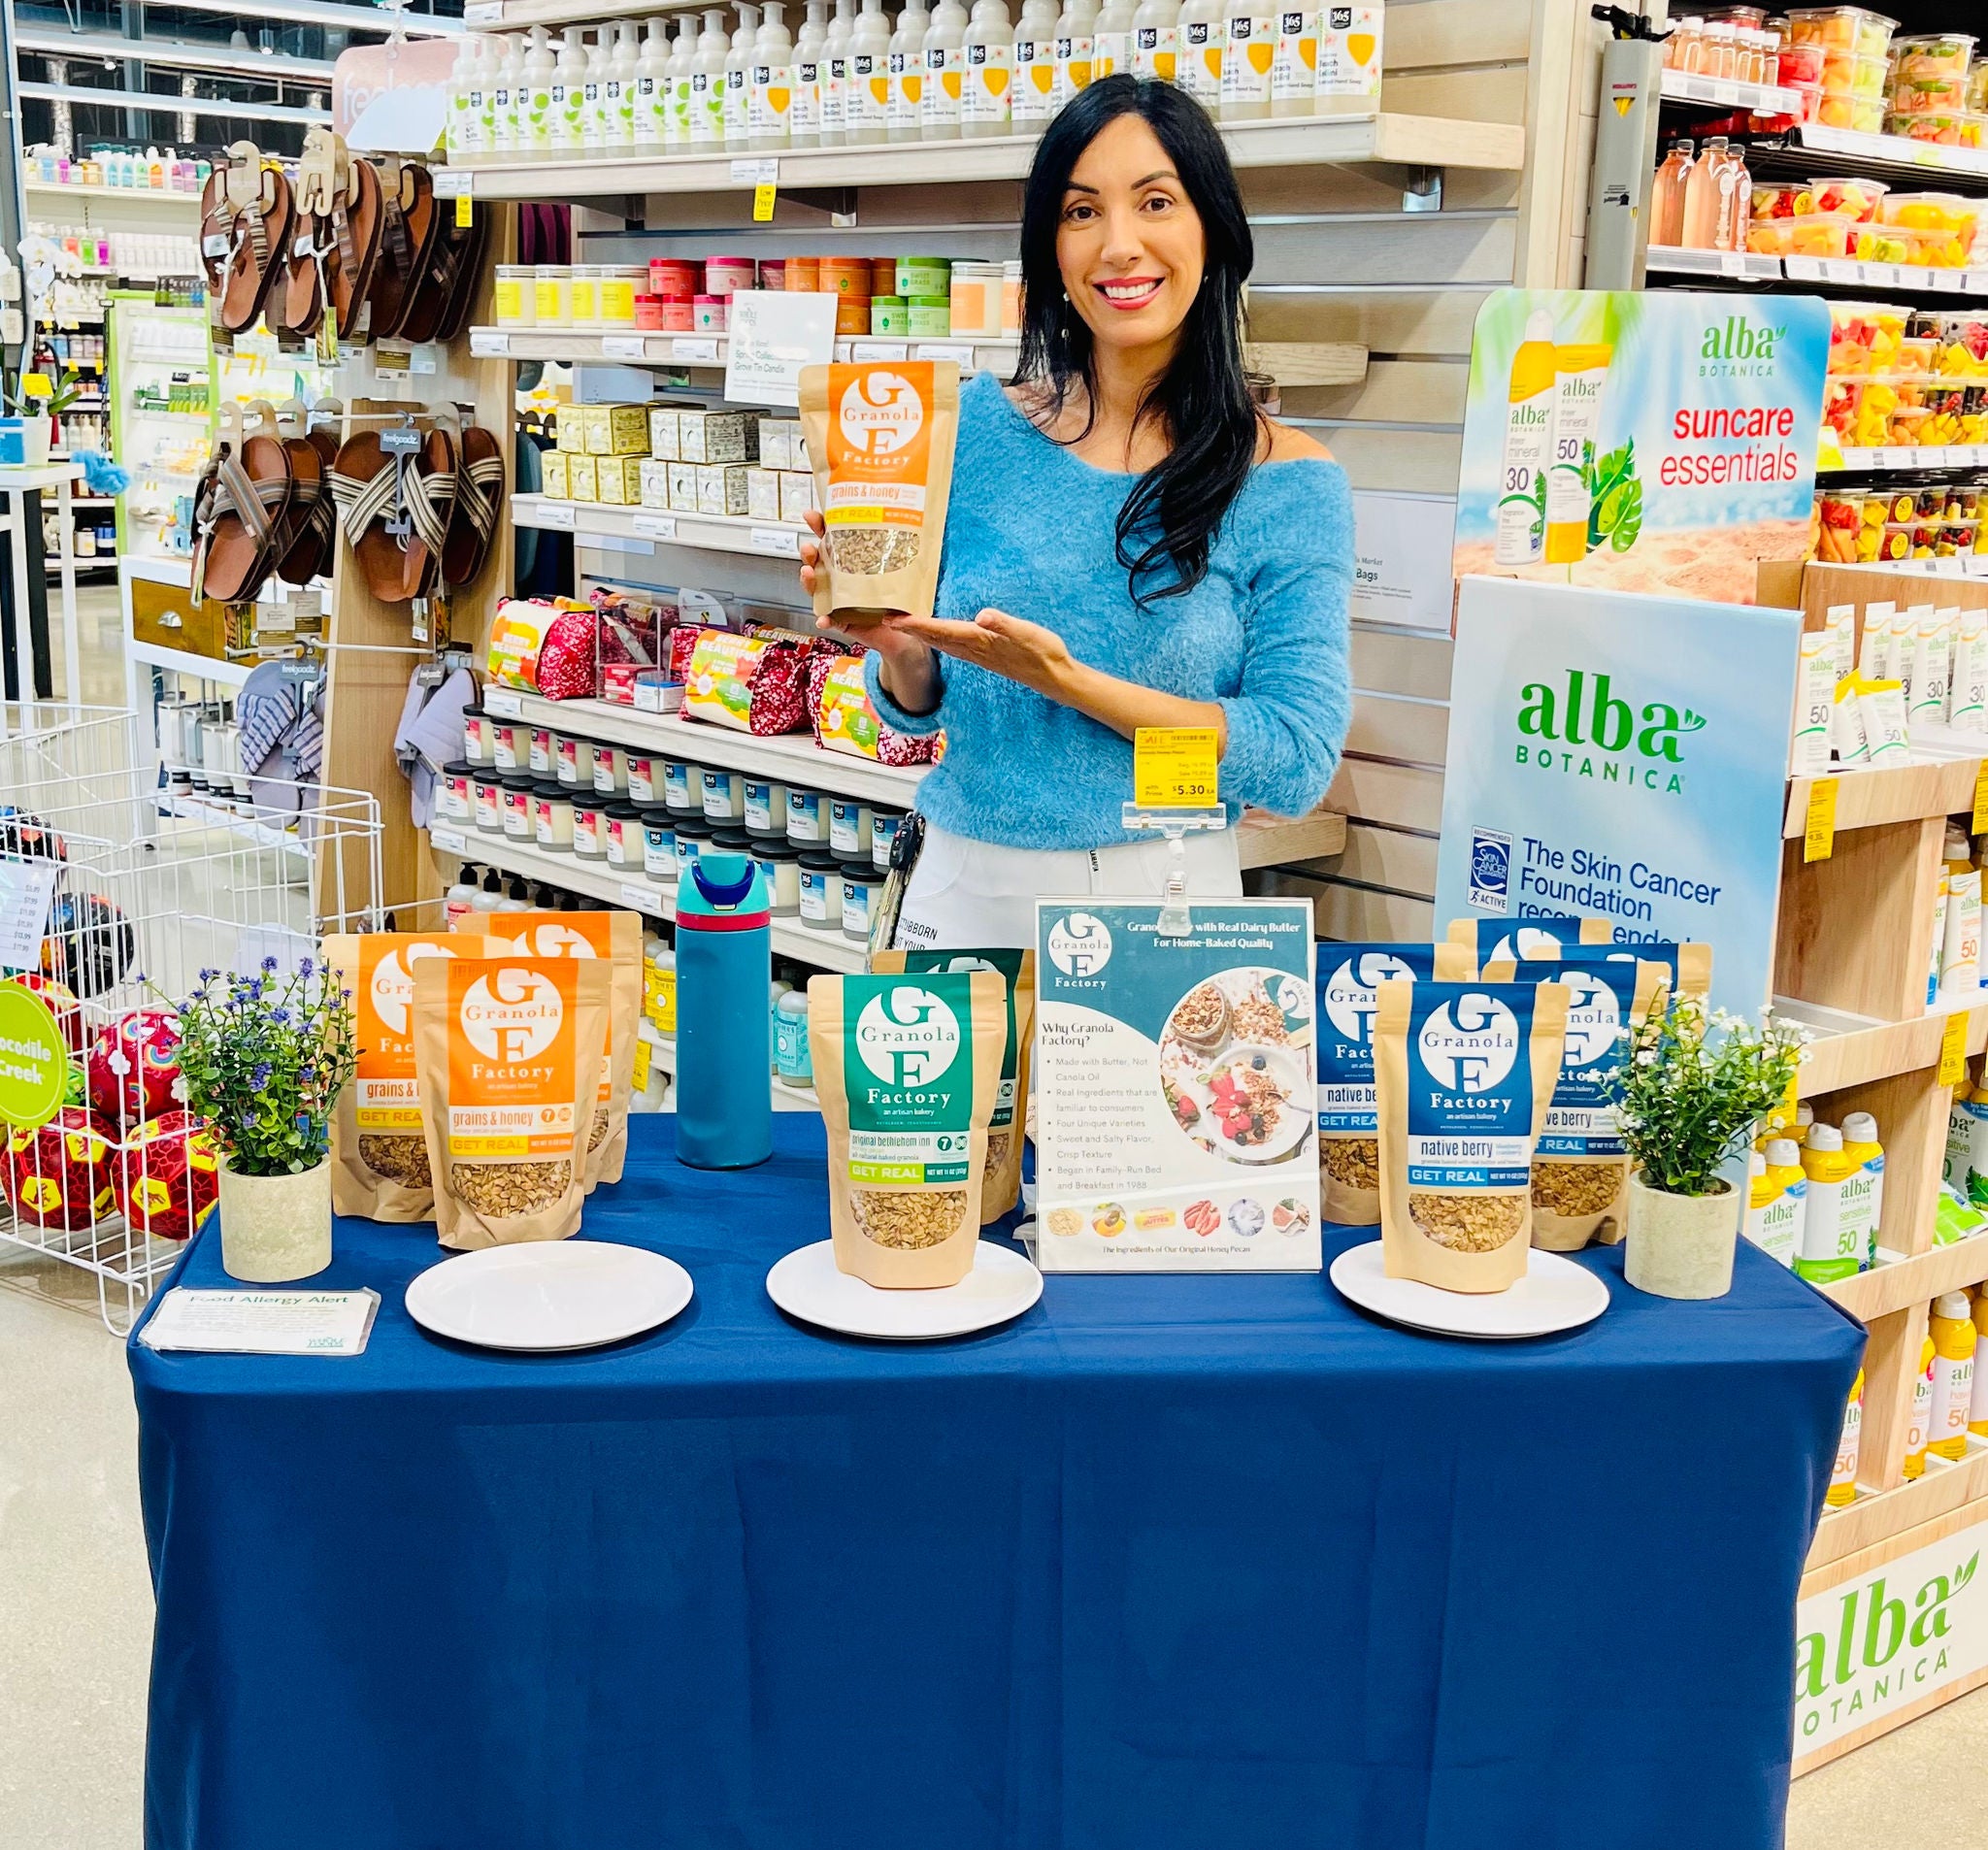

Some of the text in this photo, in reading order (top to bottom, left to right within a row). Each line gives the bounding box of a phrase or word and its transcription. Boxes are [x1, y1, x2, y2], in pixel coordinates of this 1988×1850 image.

[1284, 15, 1303, 28] 365
[1331, 10, 1351, 22] 365
[1188, 25, 1208, 39] 365
[1233, 20, 1251, 33] 365
[855, 56, 872, 69] 365
[1701, 316, 1780, 360] alba
[1699, 364, 1774, 378] BOTANICA
[1563, 379, 1599, 397] alba
[844, 407, 919, 422] Granola
[1510, 405, 1548, 424] alba
[1673, 408, 1794, 440] suncare
[1557, 439, 1578, 459] 50
[843, 450, 911, 467] Factory
[1660, 442, 1798, 486] essentials
[1506, 467, 1530, 491] 30
[831, 486, 859, 500] grains
[870, 485, 900, 501] honey
[1356, 569, 1379, 582] Bags
[1927, 680, 1943, 698] 30
[1970, 685, 1986, 703] 30
[1517, 669, 1694, 763] alba
[1809, 705, 1829, 724] 50
[1884, 729, 1901, 742] 50
[1515, 744, 1684, 794] BOTANICA
[1173, 784, 1205, 795] $5.30
[1474, 829, 1511, 842] RECOMMENDED
[1479, 848, 1500, 864] SKIN
[1473, 856, 1508, 874] CANCER
[1523, 838, 1722, 907] The Skin Cancer
[1481, 894, 1507, 908] ACTIVE
[1520, 868, 1653, 921] Foundation
[1196, 922, 1301, 935] with Real Dairy Butter
[1051, 939, 1110, 950] Granola
[1153, 938, 1274, 950] For Home-Baked Quality
[1961, 940, 1977, 958] 50
[1054, 977, 1107, 991] Factory
[465, 1004, 560, 1020] Granola
[861, 1026, 955, 1043] Granola
[1042, 1022, 1114, 1037] Why Granola
[1042, 1036, 1091, 1049] Factory?
[1424, 1031, 1513, 1048] Granola
[1055, 1057, 1148, 1069] Made with Butter, Not
[472, 1064, 555, 1083] Factory
[1055, 1073, 1100, 1081] Canola Oil
[367, 1082, 415, 1099] grains &
[867, 1088, 951, 1108] Factory
[1056, 1088, 1075, 1097] Real
[1077, 1088, 1123, 1099] Ingredients
[1126, 1088, 1140, 1097] that
[1328, 1088, 1362, 1103] native
[1056, 1104, 1086, 1112] familiar
[1430, 1093, 1512, 1113] Factory
[361, 1111, 389, 1122] GET
[453, 1111, 534, 1127] grains & honey
[1320, 1116, 1347, 1126] GET
[1562, 1110, 1592, 1129] berry
[1056, 1119, 1146, 1130] Four Unique Varieties
[452, 1140, 482, 1150] GET
[486, 1140, 525, 1150] REAL
[852, 1135, 930, 1148] original bethlehem inn
[1056, 1135, 1154, 1145] Sweet and Salty Flavor,
[1545, 1140, 1583, 1151] REAL
[1056, 1150, 1112, 1160] Crisp Texture
[1421, 1140, 1493, 1158] native berry
[852, 1165, 920, 1178] GET REAL
[1057, 1165, 1162, 1175] Began in Family-Run Bed
[1411, 1170, 1485, 1182] GET REAL
[1057, 1181, 1147, 1190] and Breakfast in 1988
[1841, 1177, 1873, 1199] alba
[1764, 1204, 1796, 1225] alba
[1839, 1206, 1872, 1222] sensitive
[1838, 1230, 1857, 1255] 50
[241, 1296, 302, 1305] Allergy
[1947, 1408, 1968, 1428] 50
[1796, 1570, 1966, 1704] alba
